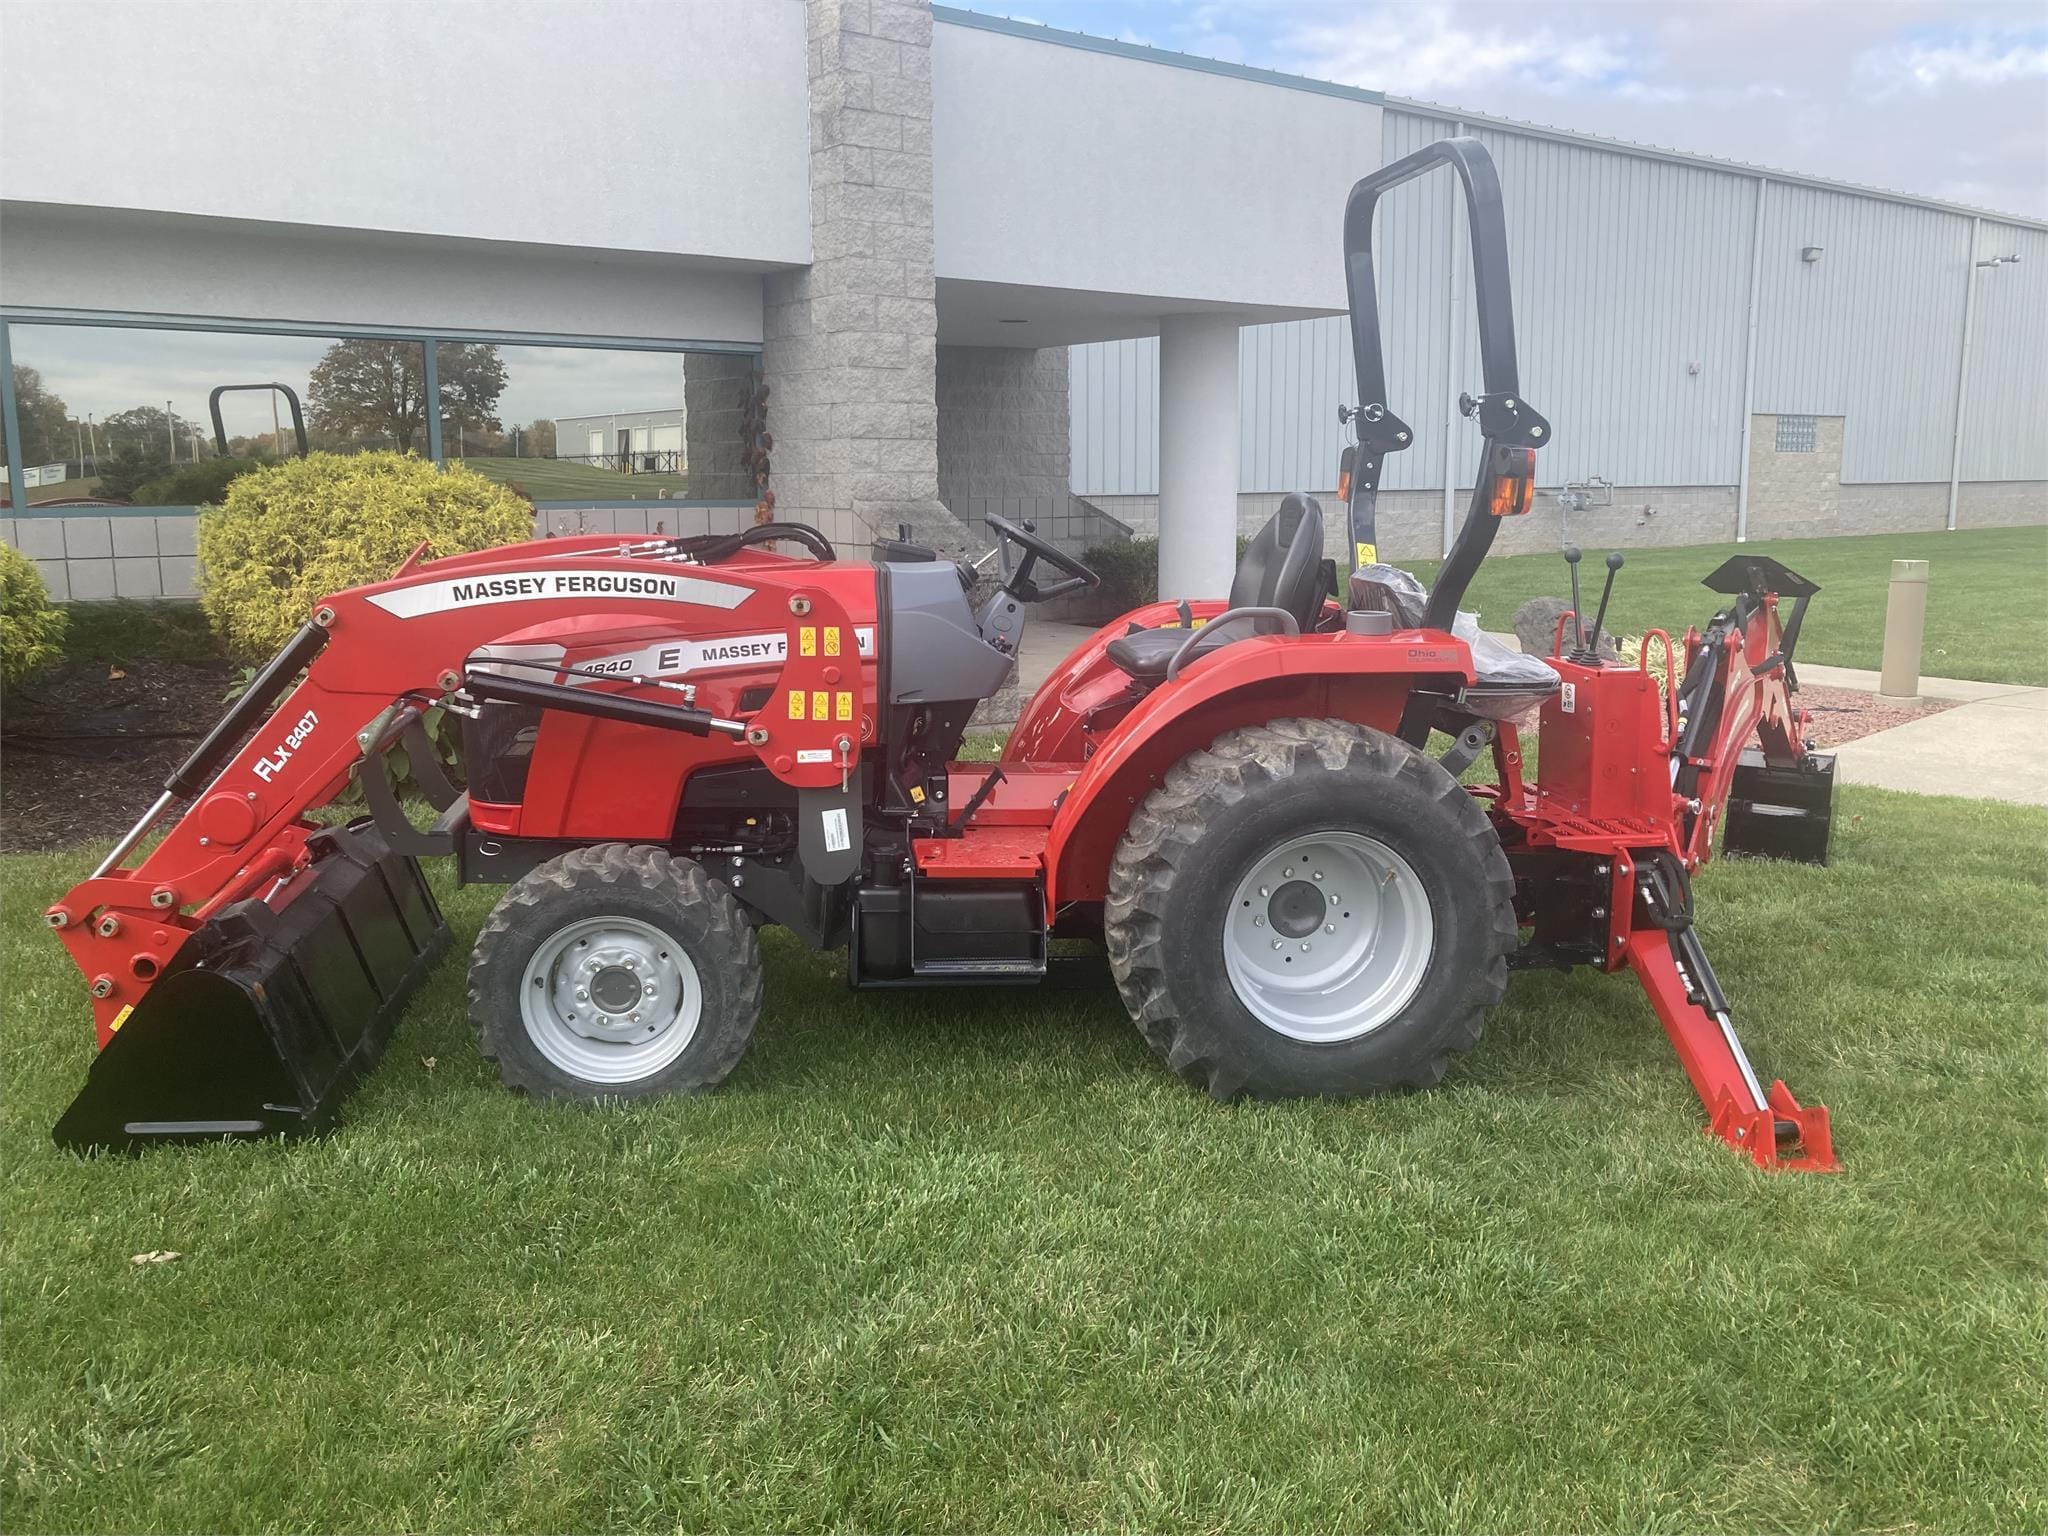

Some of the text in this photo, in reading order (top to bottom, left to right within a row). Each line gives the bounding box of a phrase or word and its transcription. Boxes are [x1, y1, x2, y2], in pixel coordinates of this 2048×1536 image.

[452, 576, 676, 601] MASSEY FERGUSON
[658, 648, 680, 670] E
[702, 643, 772, 661] MASSEY
[1408, 649, 1436, 658] Ohio
[252, 709, 319, 783] FLX 2407
